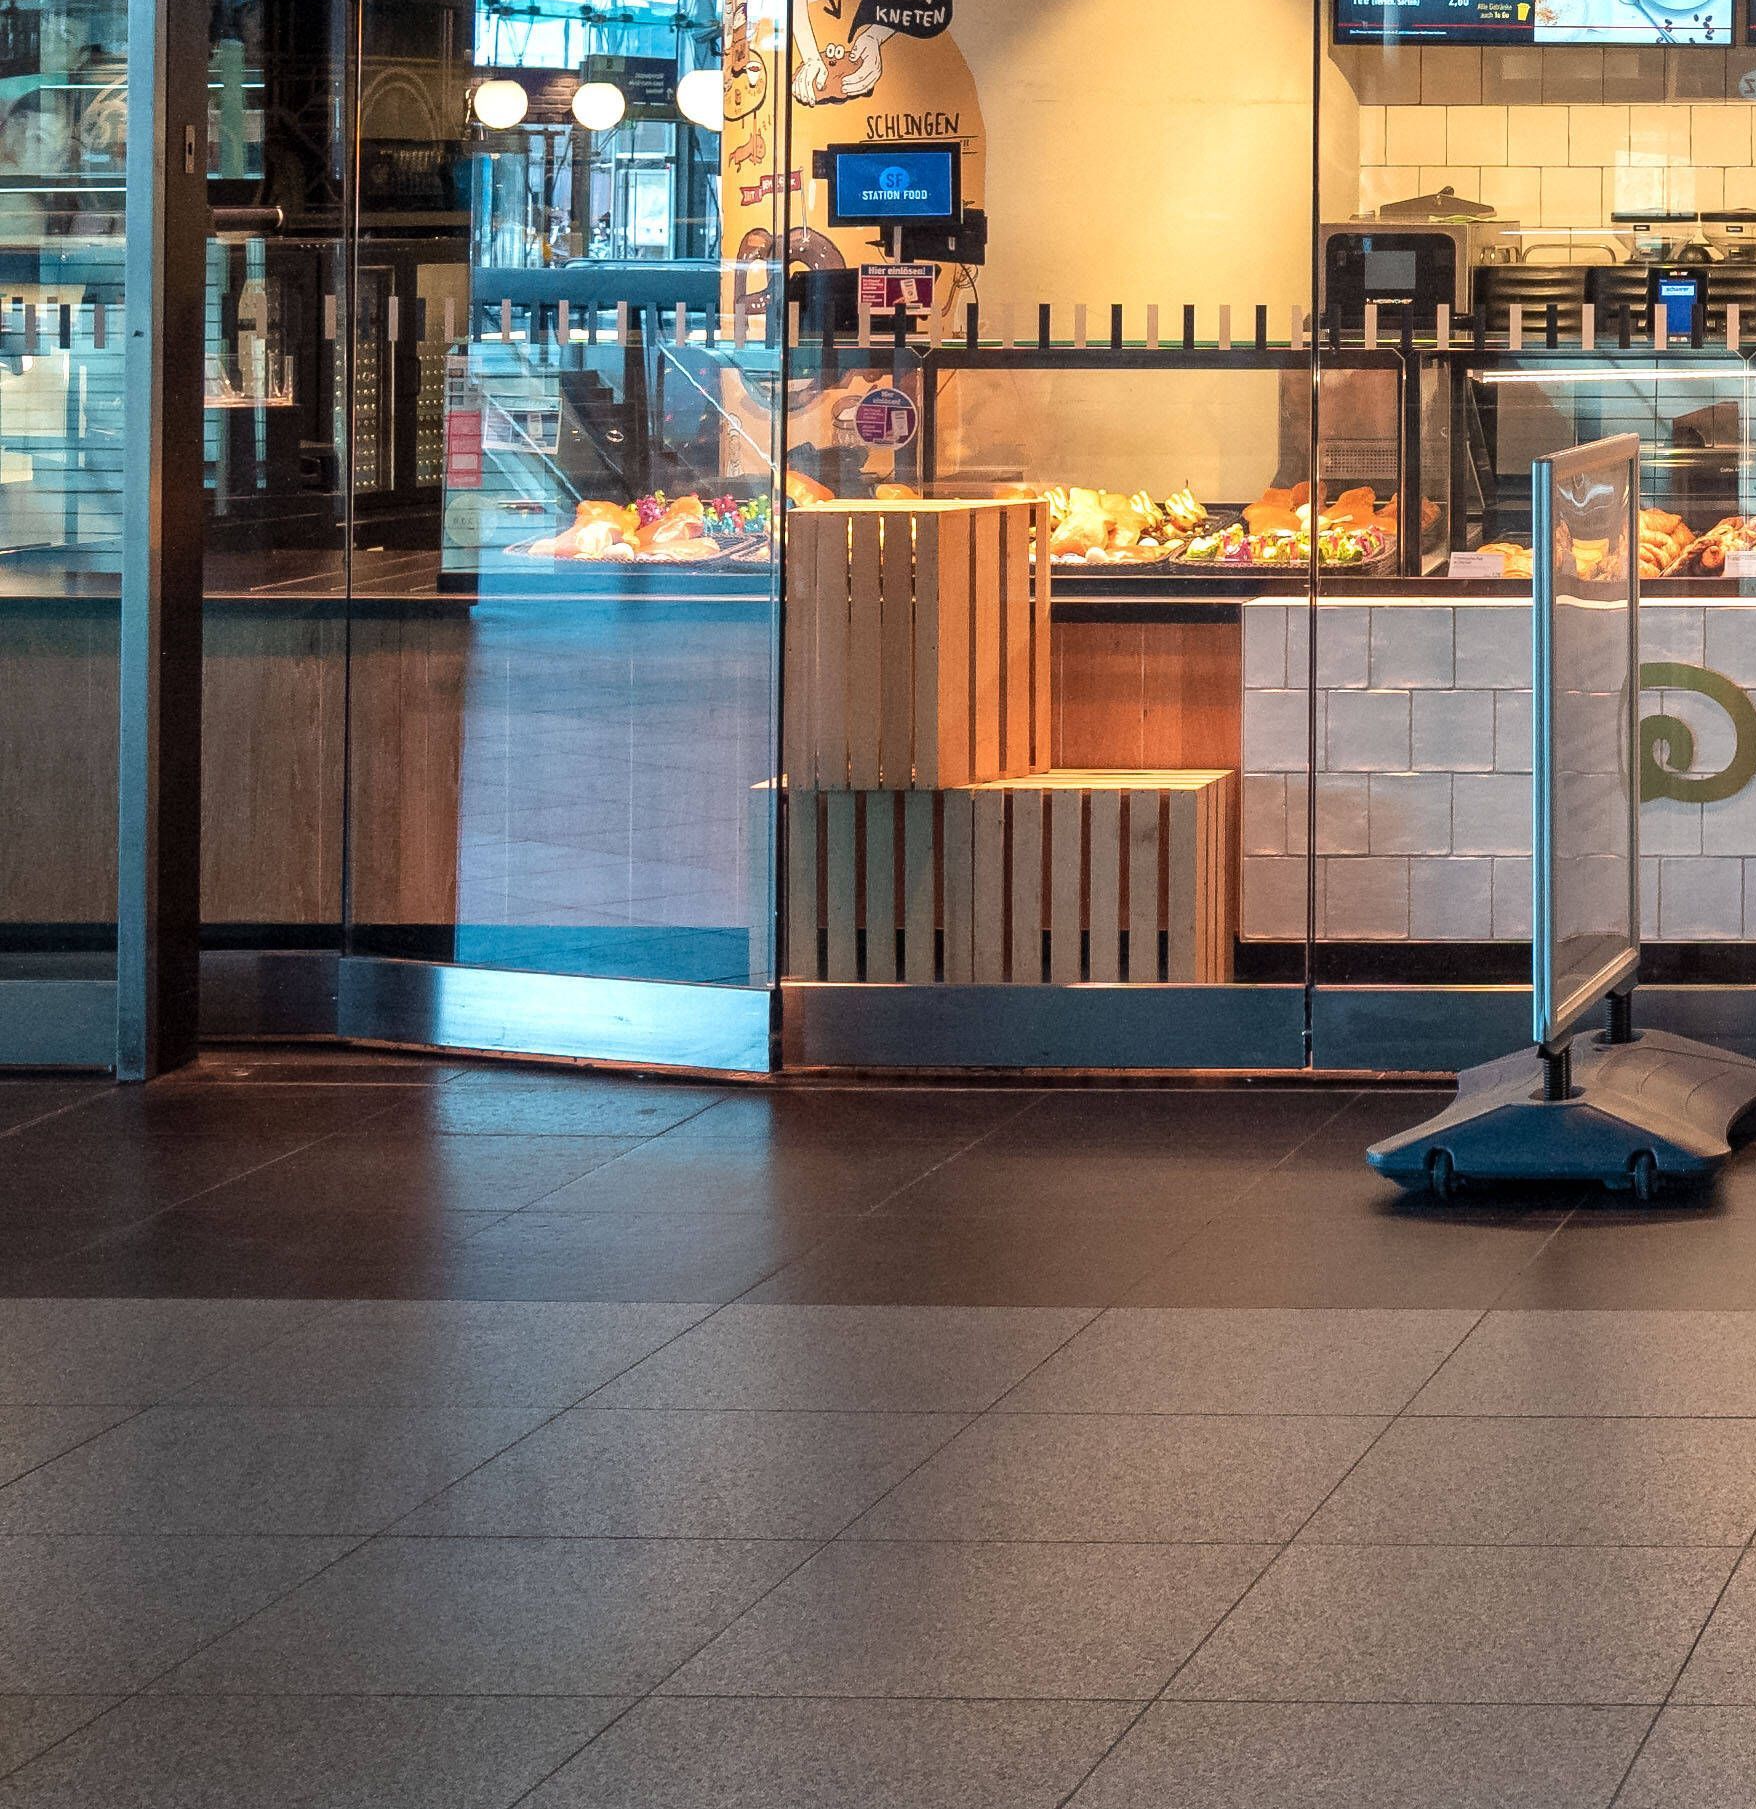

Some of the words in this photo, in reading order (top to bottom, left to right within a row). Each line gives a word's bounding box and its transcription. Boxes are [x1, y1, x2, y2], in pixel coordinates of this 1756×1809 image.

[876, 5, 946, 28] KNETEN
[866, 112, 960, 139] SCHLINGEN
[885, 173, 903, 188] SF
[861, 190, 900, 201] STATION
[903, 190, 928, 200] FOOD
[868, 265, 887, 275] Hier
